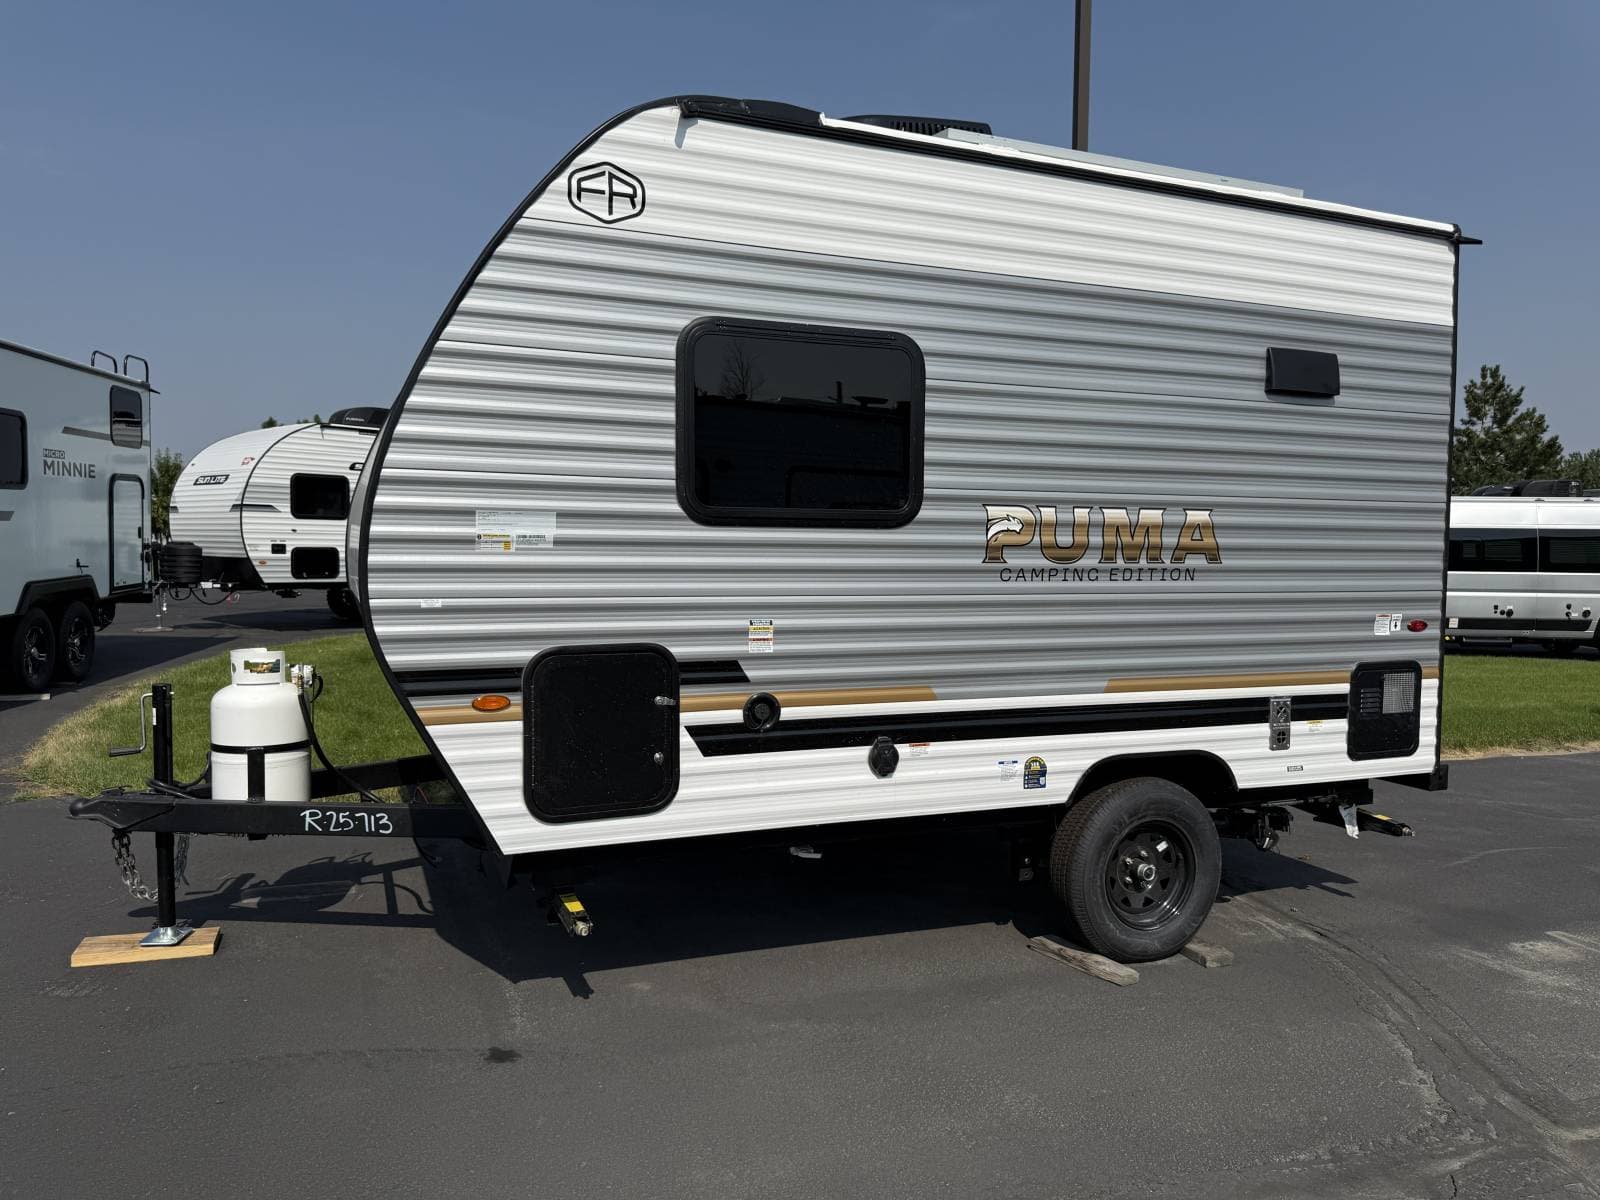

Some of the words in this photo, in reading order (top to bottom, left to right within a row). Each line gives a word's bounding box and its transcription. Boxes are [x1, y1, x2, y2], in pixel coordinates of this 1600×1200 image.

[43, 448, 65, 459] MICRO
[43, 459, 96, 479] MINNIE
[982, 504, 1222, 564] PUMA
[999, 568, 1099, 582] CAMPING
[1109, 567, 1196, 582] EDITION
